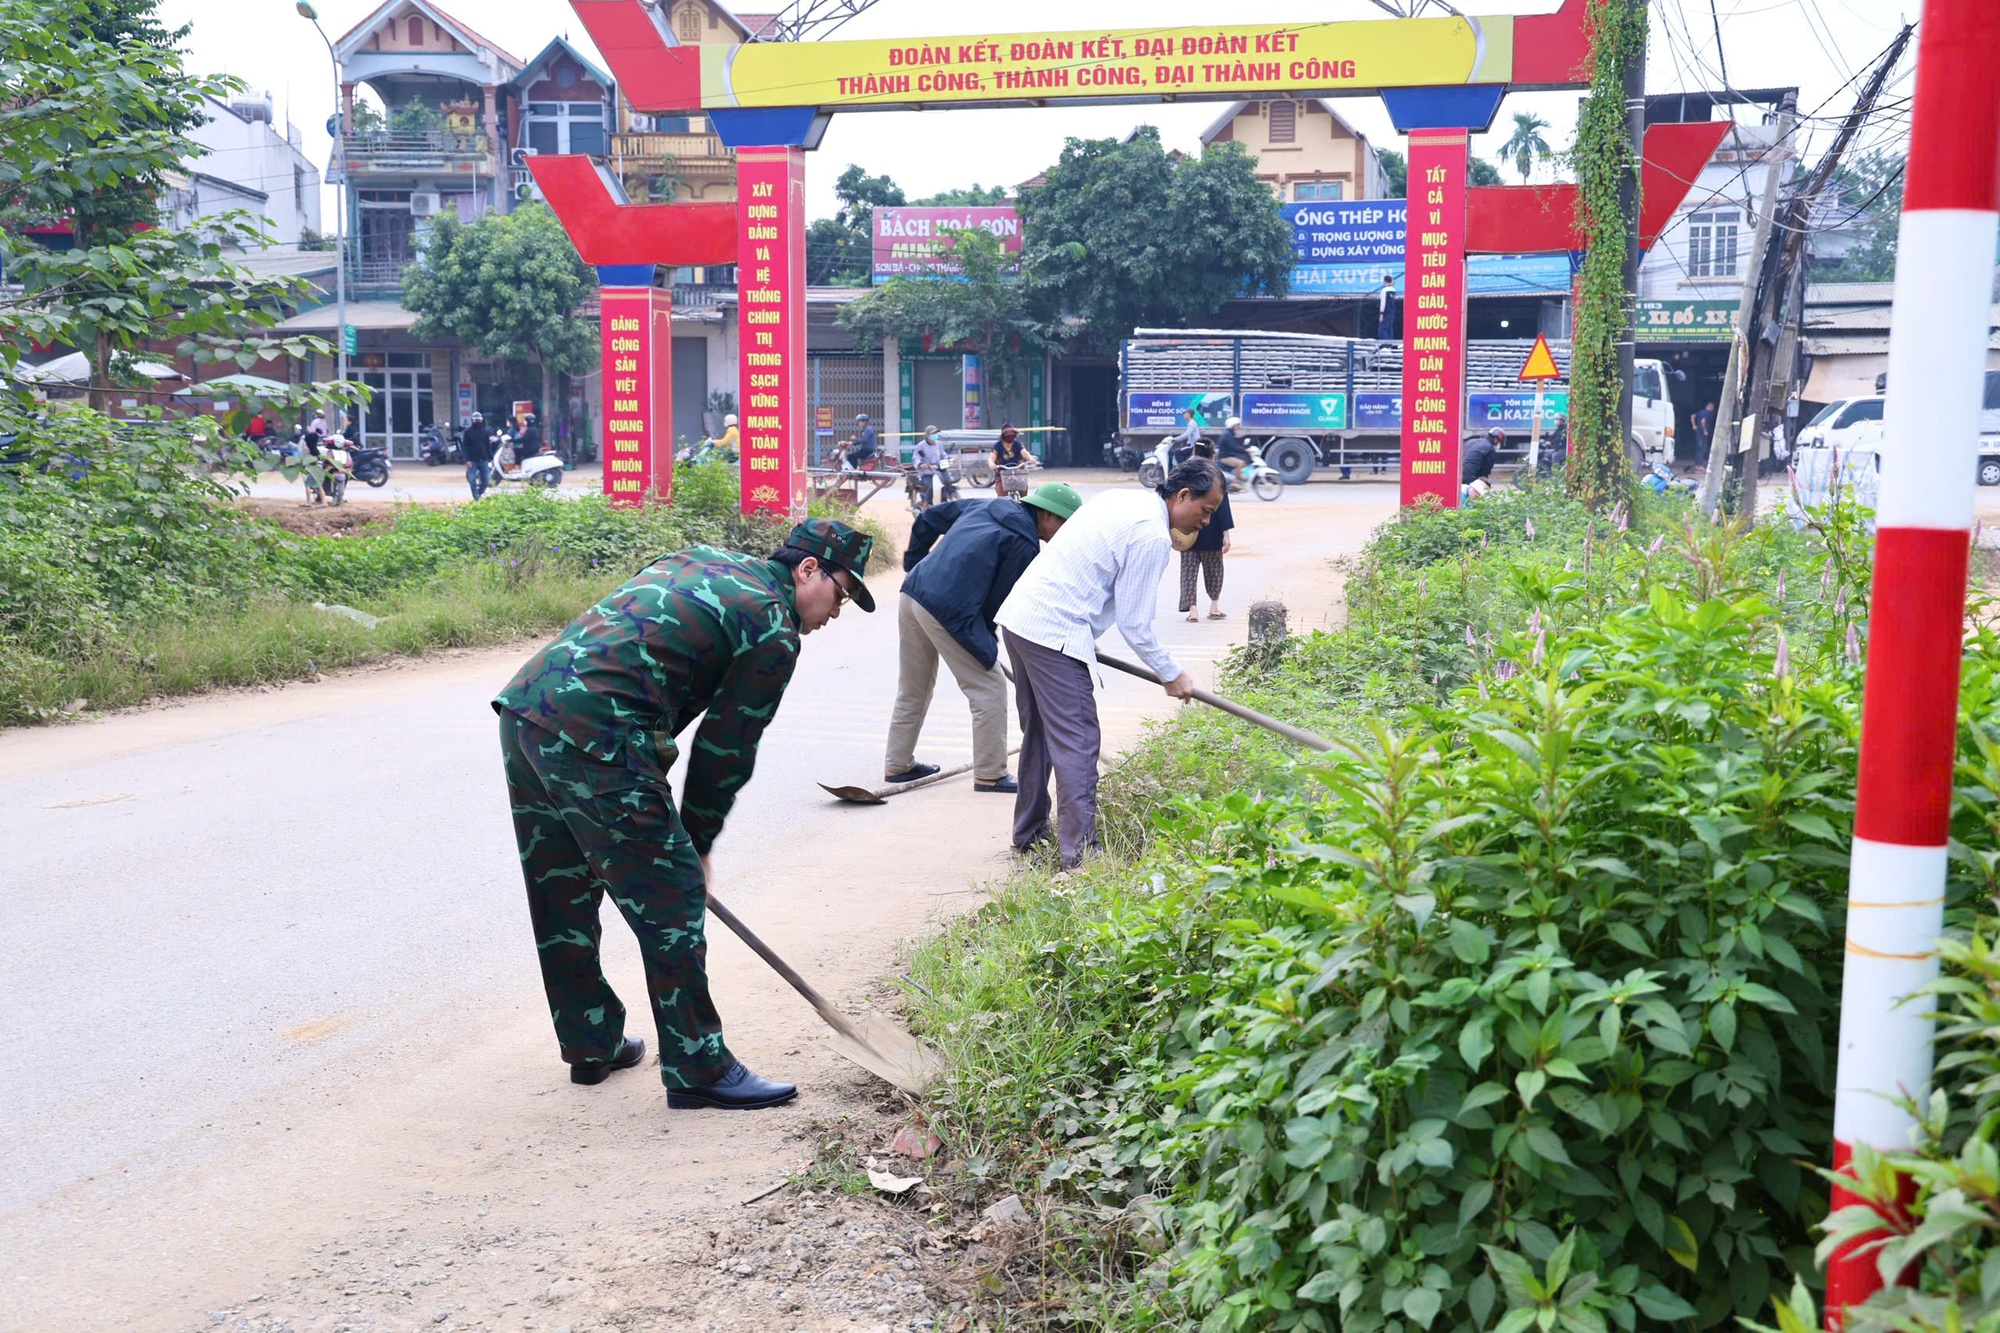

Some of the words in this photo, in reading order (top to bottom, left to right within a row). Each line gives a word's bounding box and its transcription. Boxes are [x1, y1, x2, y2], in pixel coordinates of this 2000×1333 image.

[889, 43, 951, 66] ĐOÀN
[958, 38, 1003, 64] KẾT,
[1010, 38, 1074, 61] ĐOÀN
[1082, 34, 1127, 59] KẾT,
[1134, 38, 1173, 60] ĐẠI
[1181, 32, 1247, 55] ĐOÀN
[1255, 28, 1299, 53] KẾT
[837, 73, 910, 95] THÀNH
[918, 70, 986, 92] CÔNG,
[993, 67, 1068, 88] THÀNH
[1076, 64, 1148, 87] CÔNG,
[1155, 65, 1194, 87] ĐẠI
[1202, 60, 1281, 82] THÀNH
[1289, 57, 1356, 80] CÔNG
[1426, 164, 1446, 183] TẤT
[752, 182, 773, 197] XÂY
[1428, 186, 1444, 204] CẢ
[748, 204, 778, 221] DỰNG
[1294, 207, 1334, 226] ỐNG
[1339, 208, 1384, 225] THÉP
[1430, 208, 1440, 225] VÌ
[748, 223, 778, 240] ĐẢNG
[880, 214, 930, 236] BÁCH
[1312, 232, 1351, 243] TRỌNG
[1354, 231, 1394, 242] LƯỢNG
[1422, 232, 1448, 249] MỤC
[756, 246, 770, 261] VÀ
[1312, 246, 1344, 258] DỰNG
[1347, 245, 1370, 256] XÂY
[1372, 244, 1406, 254] VỮNG
[1422, 251, 1446, 267] TIÊU
[756, 266, 770, 284] HỆ
[1422, 272, 1445, 288] DÂN
[746, 286, 781, 303] THỐNG
[1418, 293, 1448, 310] GIÀU,
[610, 314, 640, 331] ĐẢNG
[748, 308, 780, 324] CHÍNH
[1417, 314, 1448, 330] NƯỚC
[1672, 305, 1694, 324] SỐ
[612, 336, 640, 354] CỘNG
[756, 332, 772, 348] TRỊ
[1414, 337, 1450, 354] MẠNH,
[615, 356, 636, 372] SẢN
[747, 353, 782, 366] TRONG
[1420, 355, 1444, 371] DÂN
[615, 378, 636, 394] VIỆT
[750, 374, 778, 390] SẠCH
[1418, 374, 1444, 394] CHỦ,
[614, 400, 638, 412] NAM
[750, 392, 778, 408] VỮNG
[1415, 396, 1446, 413] CÔNG
[610, 420, 644, 433] QUANG
[748, 416, 782, 431] MẠNH,
[1413, 415, 1447, 434] BẰNG,
[614, 440, 638, 452] VINH
[751, 434, 778, 449] TOÀN
[1418, 438, 1440, 454] VĂN
[612, 458, 642, 472] MUÔN
[750, 455, 779, 472] DIỆN!
[1412, 460, 1446, 474] MINH!
[613, 478, 640, 492] NĂM!
